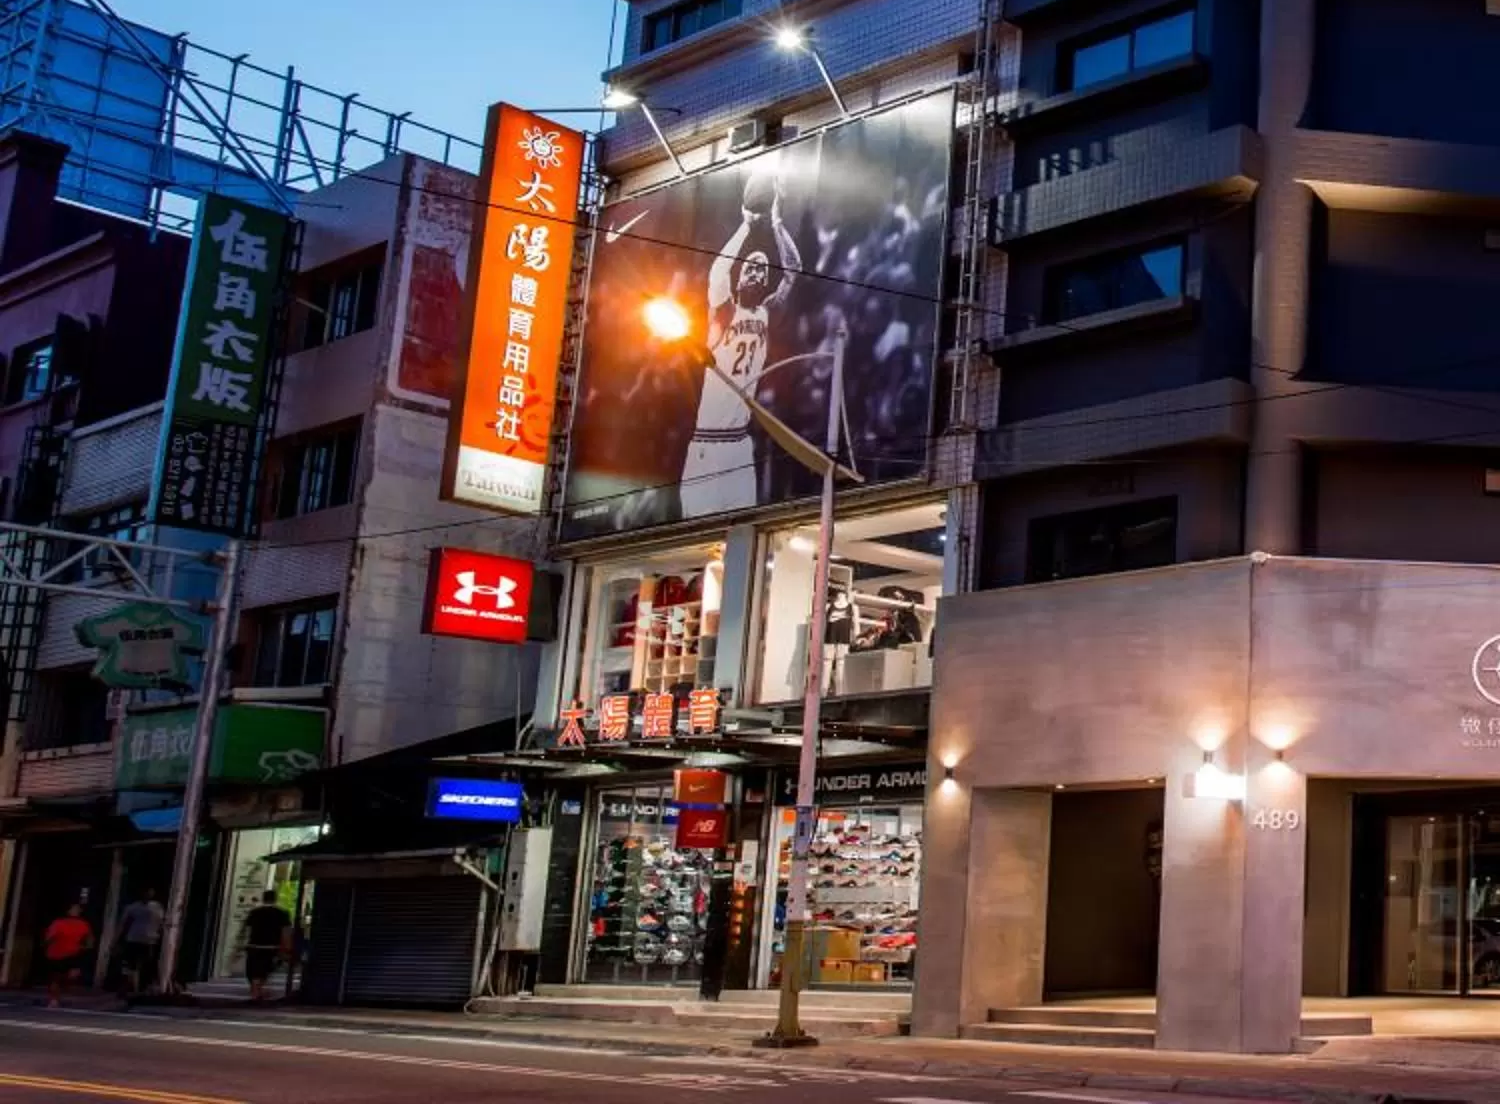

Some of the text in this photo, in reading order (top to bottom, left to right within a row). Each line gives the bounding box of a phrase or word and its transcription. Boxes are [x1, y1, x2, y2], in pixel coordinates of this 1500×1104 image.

[192, 209, 267, 413] 伍角衣版
[494, 171, 557, 442] 太陽體育用品社
[557, 686, 720, 748] 太陽體育
[131, 723, 197, 763] 伍角衣
[438, 793, 518, 807] SKECHERS
[1252, 808, 1299, 830] 489
